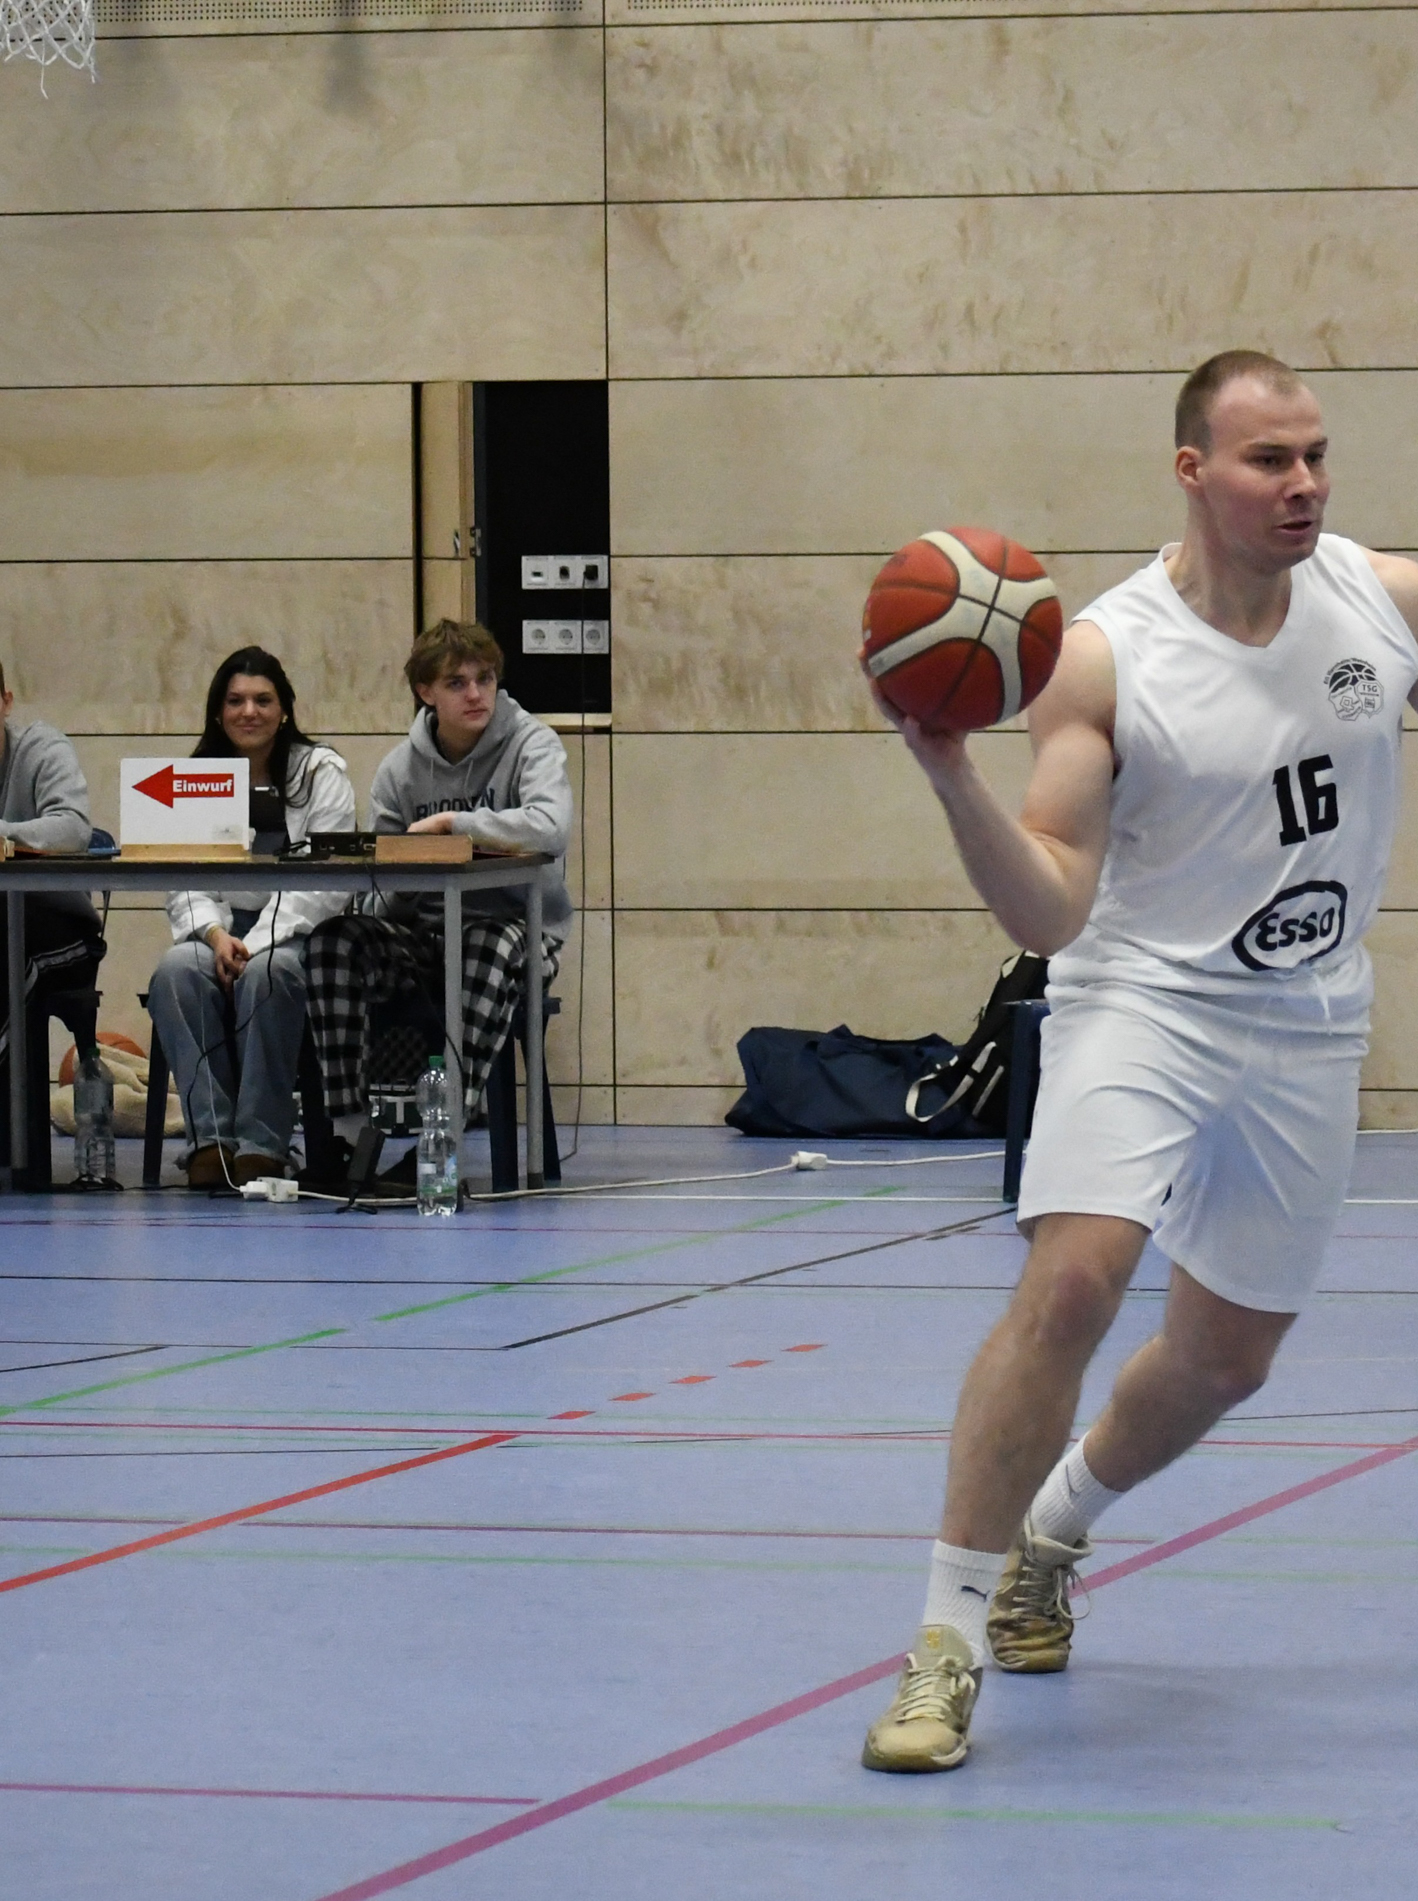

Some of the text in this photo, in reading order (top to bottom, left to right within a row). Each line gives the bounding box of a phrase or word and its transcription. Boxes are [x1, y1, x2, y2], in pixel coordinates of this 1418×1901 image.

[1362, 684, 1378, 692] TSG
[172, 779, 233, 793] Einwurf
[1272, 754, 1340, 847] 16
